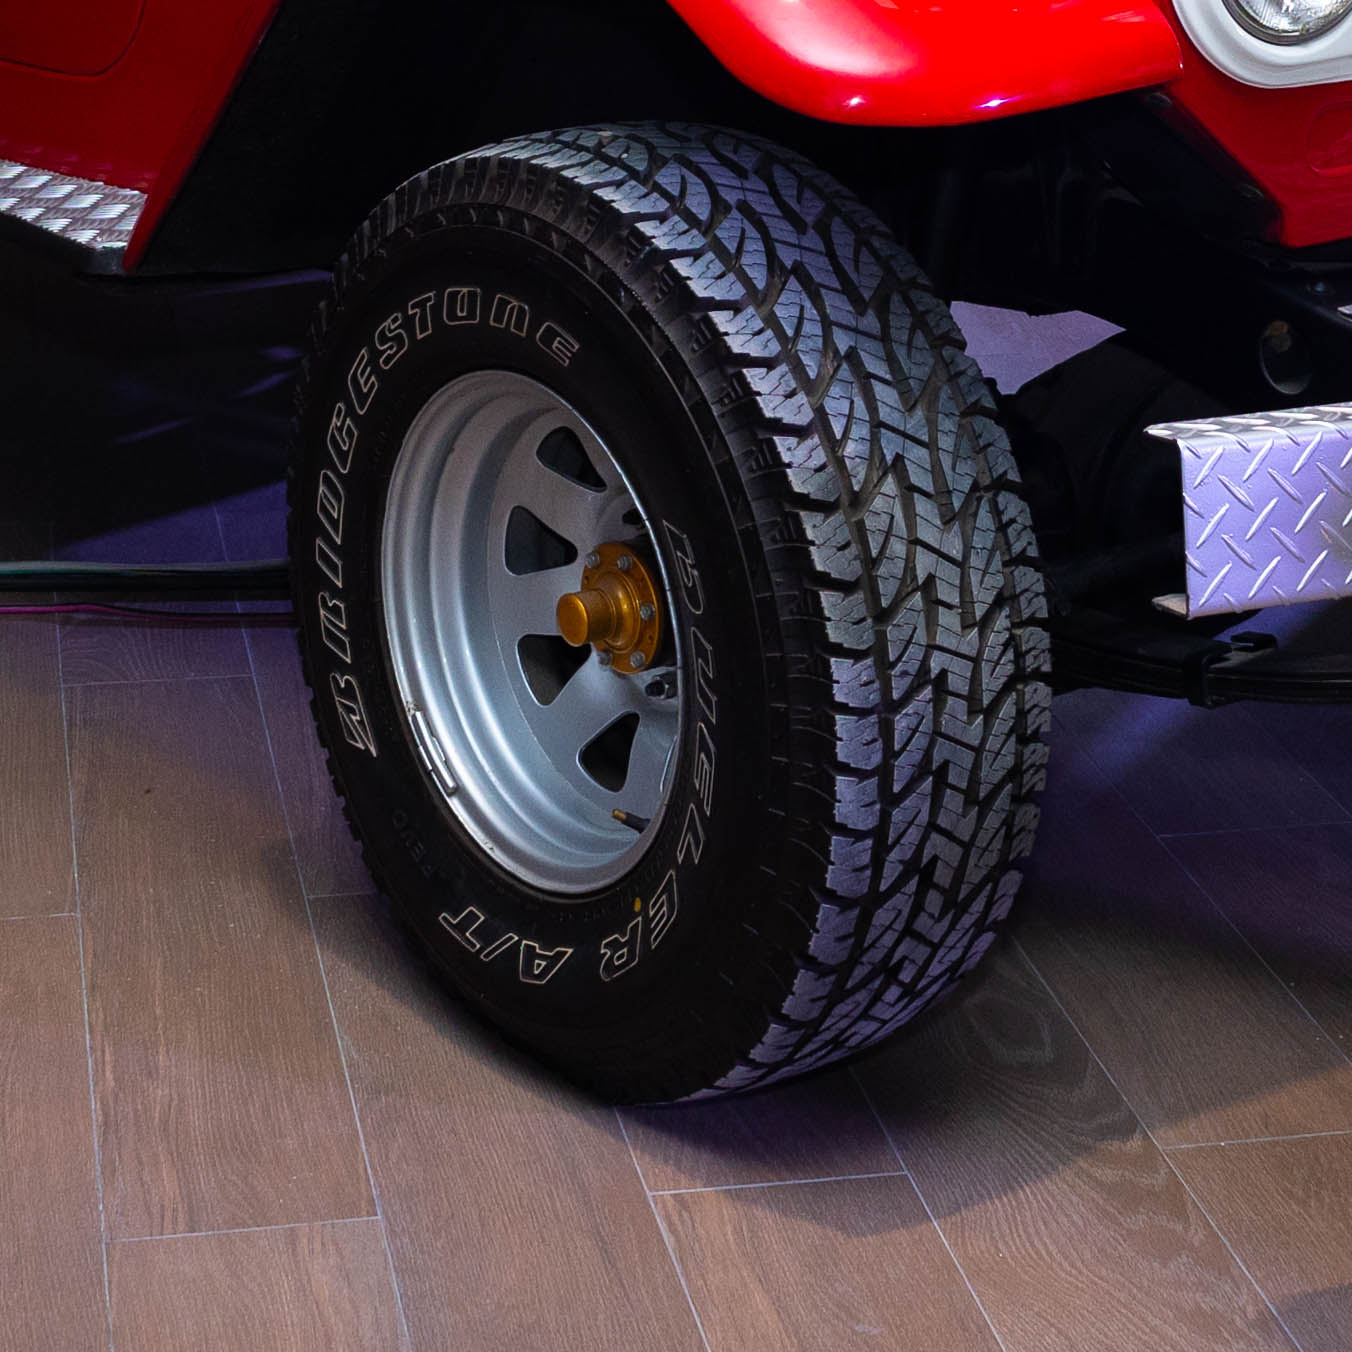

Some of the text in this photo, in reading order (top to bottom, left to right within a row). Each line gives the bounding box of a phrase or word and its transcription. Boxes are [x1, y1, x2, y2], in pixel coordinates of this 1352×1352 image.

[312, 286, 579, 757] BRIDGESTONE
[599, 518, 715, 984] DUELER
[439, 904, 574, 986] A/T
